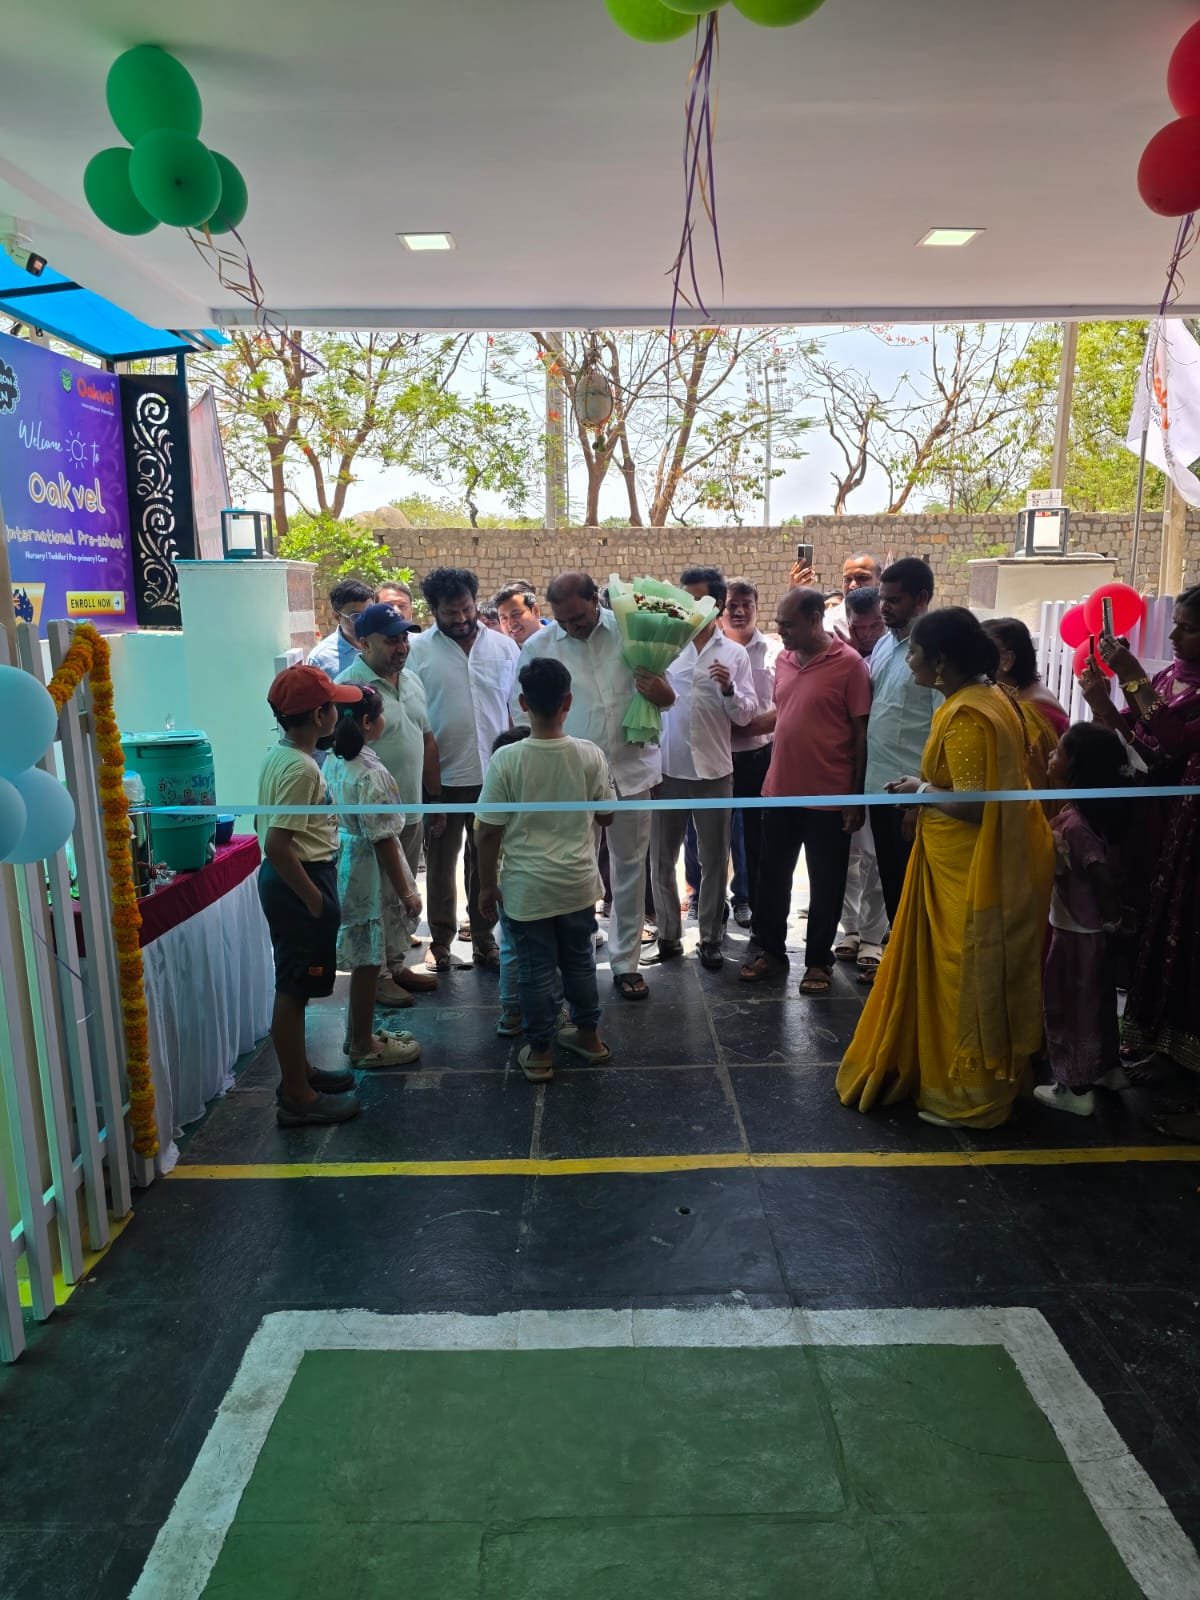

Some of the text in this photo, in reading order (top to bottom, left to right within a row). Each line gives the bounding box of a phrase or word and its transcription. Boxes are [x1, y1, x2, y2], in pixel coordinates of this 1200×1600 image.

[77, 378, 114, 406] Oakvel
[19, 420, 100, 468] Welcome to
[28, 472, 106, 514] Oakvel
[5, 524, 124, 549] International Pre-school
[25, 550, 45, 562] Nursery
[48, 552, 66, 561] Toddler
[70, 599, 111, 608] ENROLL NOW
